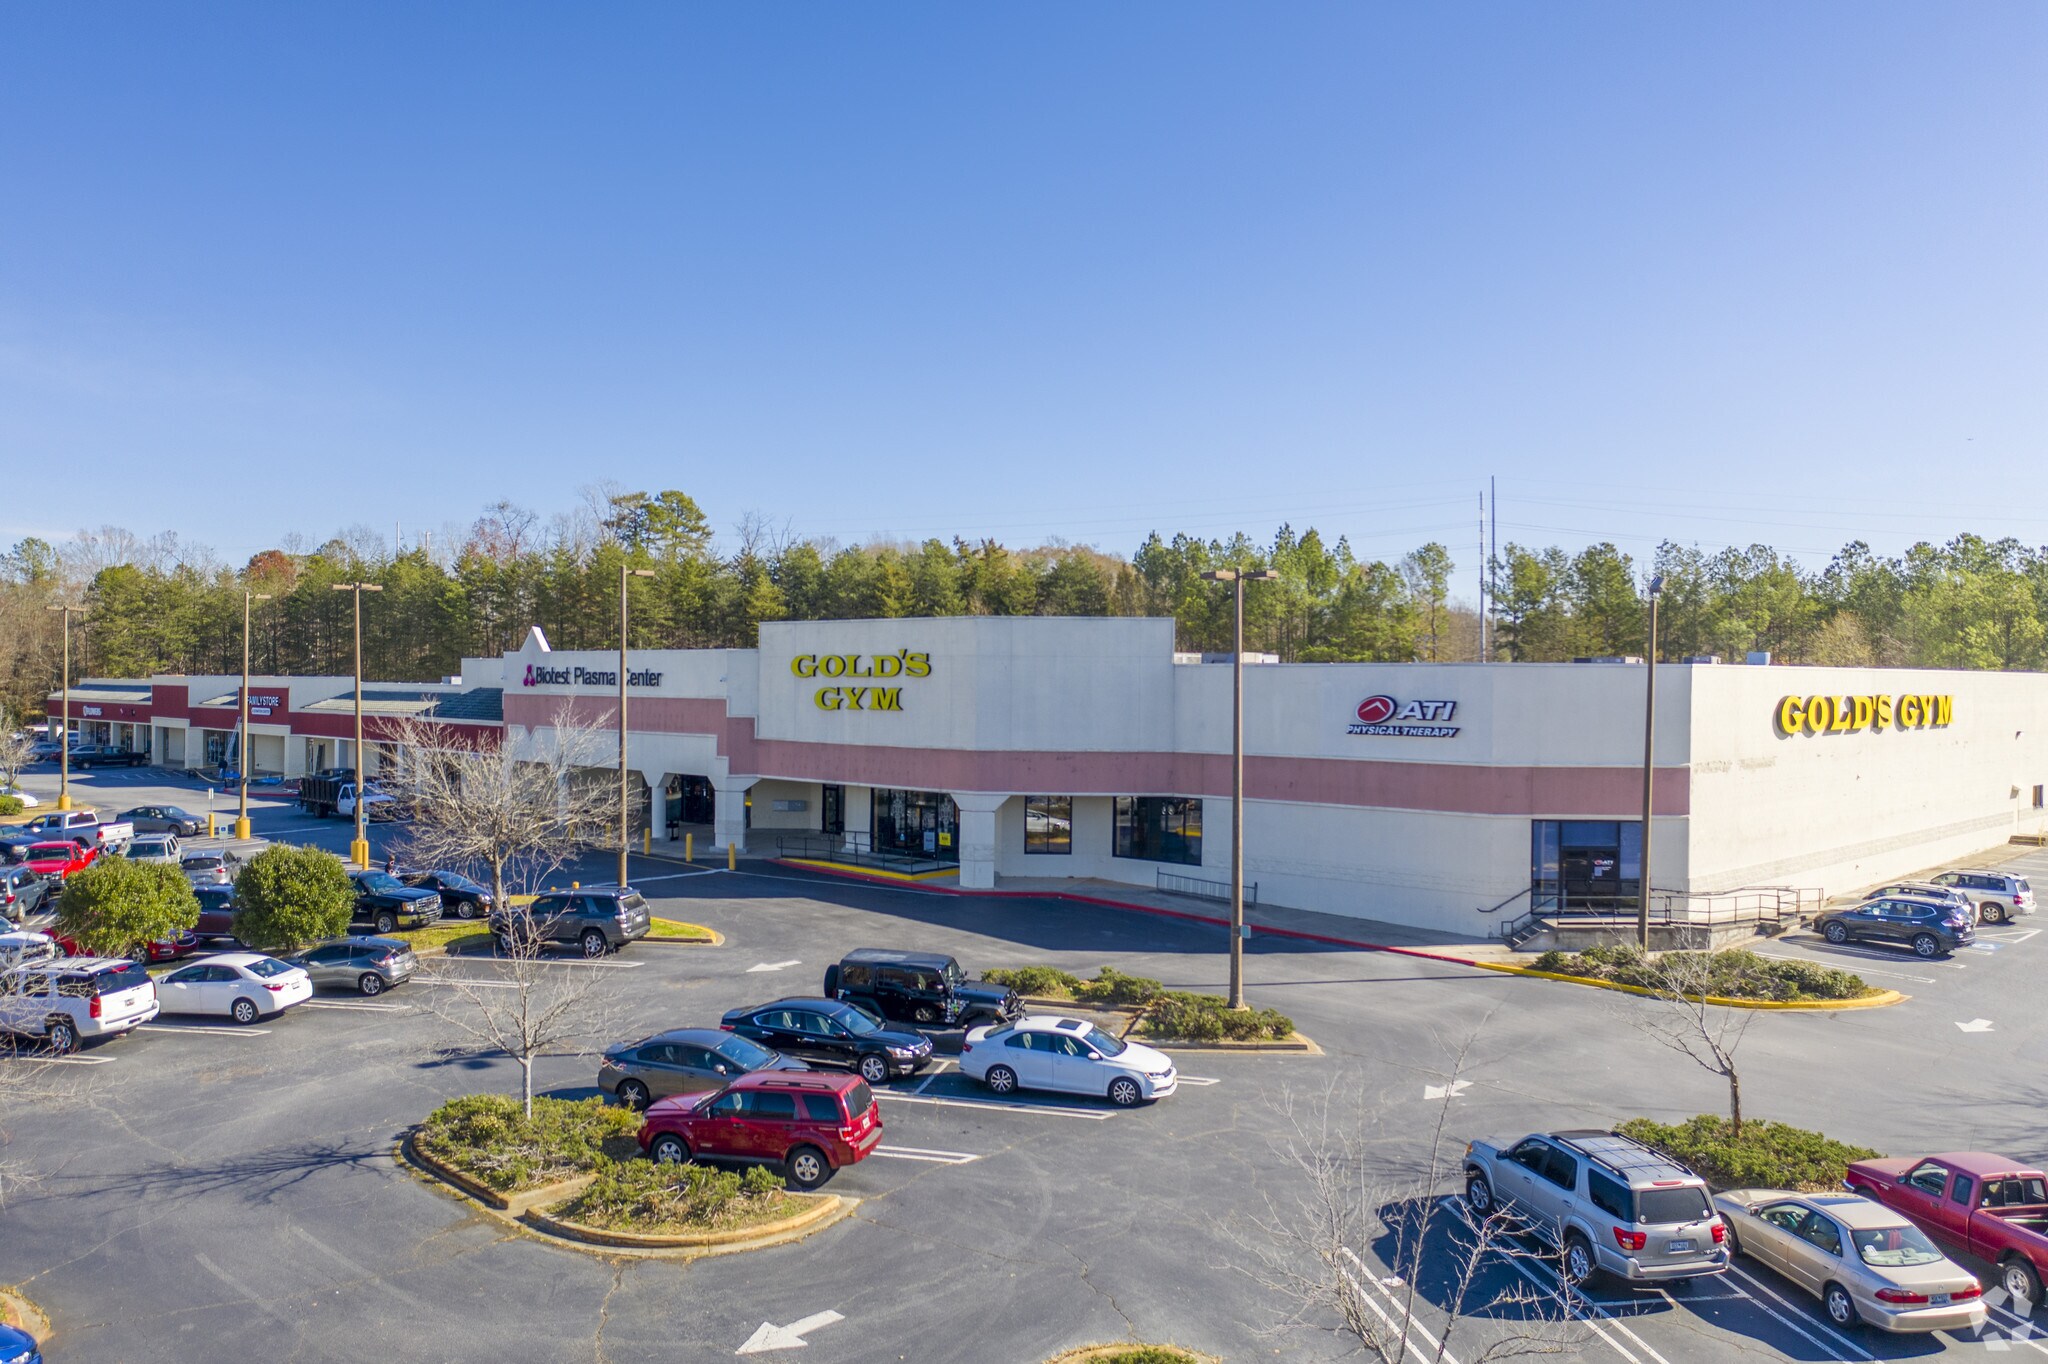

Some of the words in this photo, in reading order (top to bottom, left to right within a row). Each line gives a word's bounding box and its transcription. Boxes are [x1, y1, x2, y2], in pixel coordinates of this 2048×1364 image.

[790, 648, 932, 678] GOLD'S
[535, 666, 571, 685] Biotest
[573, 667, 616, 686] Plasma
[813, 686, 904, 711] GYM
[1396, 700, 1457, 721] ATI
[1778, 694, 1893, 735] GOLD'S
[1900, 693, 1954, 728] GYM
[1346, 725, 1401, 736] PHYSICAL
[1401, 726, 1460, 738] THERAPY
